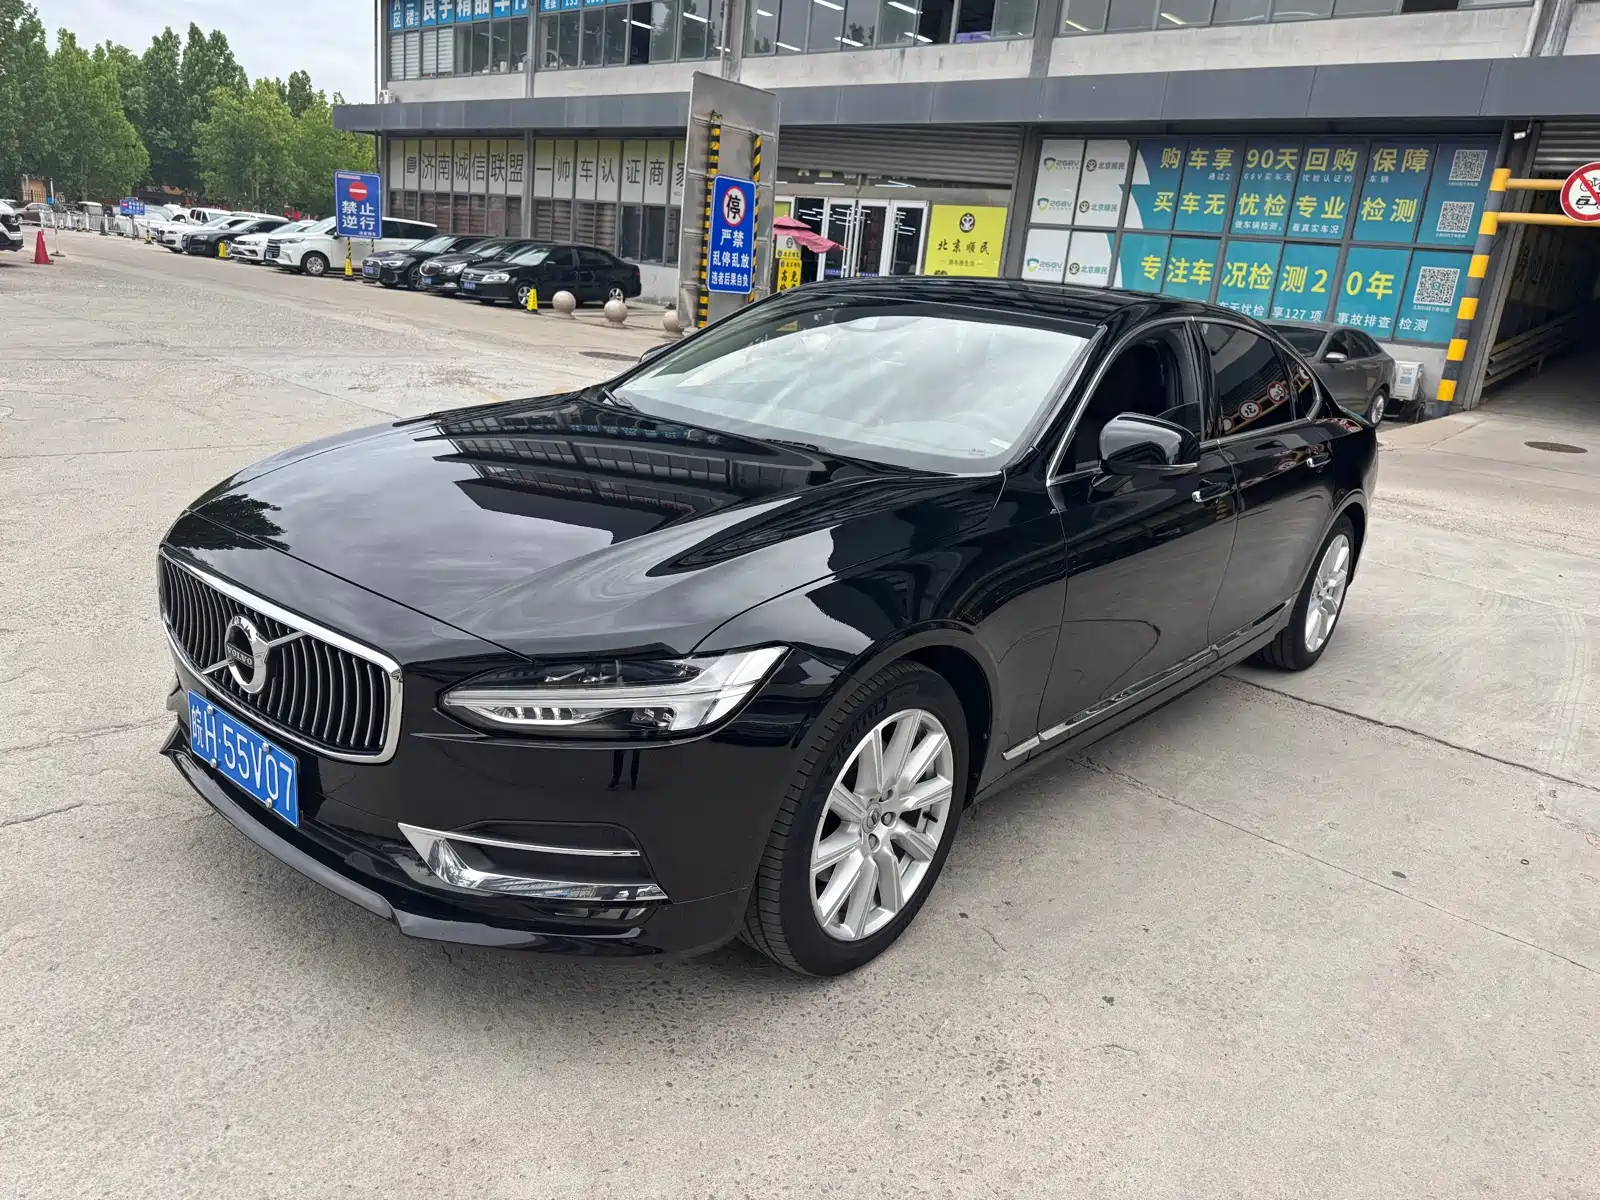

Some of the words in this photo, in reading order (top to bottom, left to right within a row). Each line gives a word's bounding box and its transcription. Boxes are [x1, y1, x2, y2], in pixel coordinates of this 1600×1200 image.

[422, 152, 523, 182] 济南诚信联盟
[1160, 147, 1430, 173] 购车享90天回购保障
[342, 200, 375, 216] 禁止
[726, 194, 741, 220] 停
[342, 215, 376, 230] 逆行
[720, 229, 744, 248] 严禁
[712, 250, 750, 268] 乱停乱放
[711, 271, 748, 287] 违者后果自负
[1140, 254, 1396, 300] 专注车况检测20年
[226, 644, 253, 666] VOLVO
